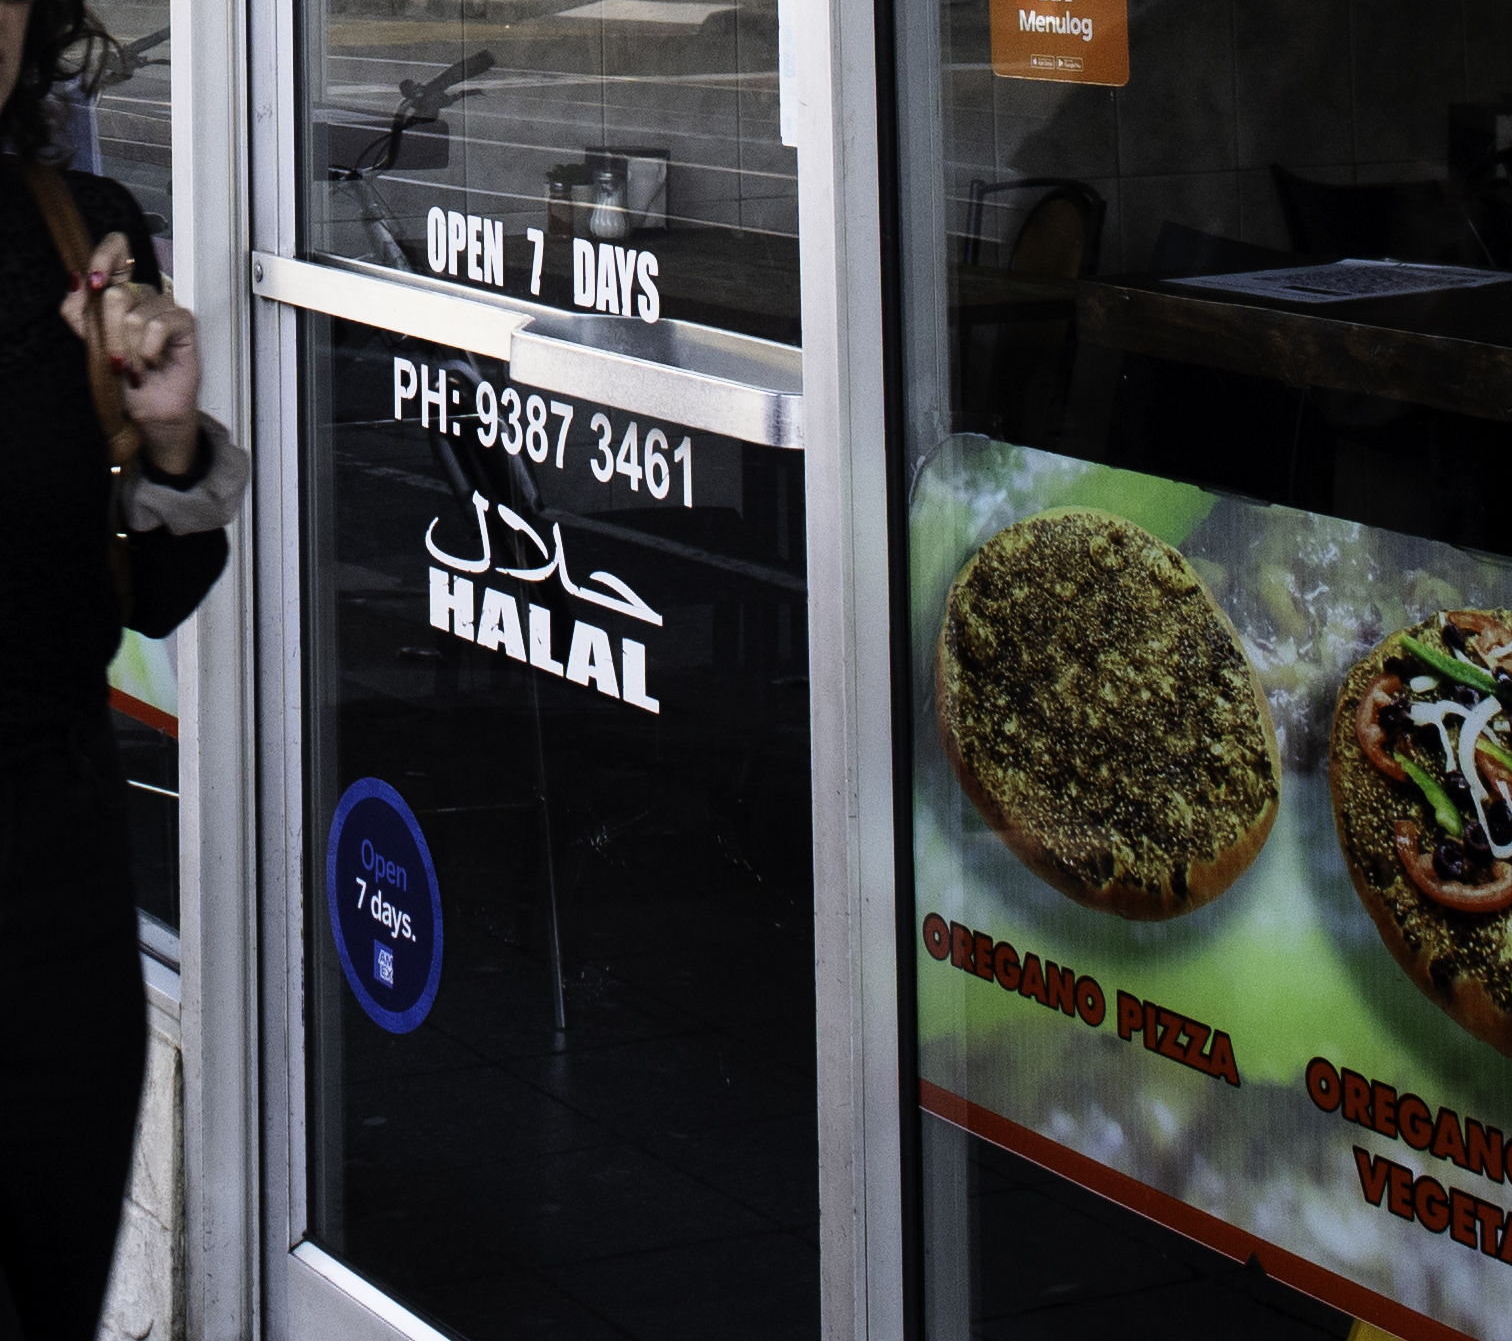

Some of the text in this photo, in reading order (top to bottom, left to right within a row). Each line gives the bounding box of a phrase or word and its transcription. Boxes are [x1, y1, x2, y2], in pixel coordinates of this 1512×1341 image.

[1019, 9, 1093, 42] Menulog
[426, 206, 660, 324] OPEN 7 DAYS
[392, 357, 695, 509] PH: 9387 3461
[424, 489, 664, 627] حلال
[428, 566, 660, 714] HALAL
[355, 877, 418, 943] 7 days.
[359, 838, 408, 892] Open
[922, 911, 1241, 1088] OREGANO PIZZA
